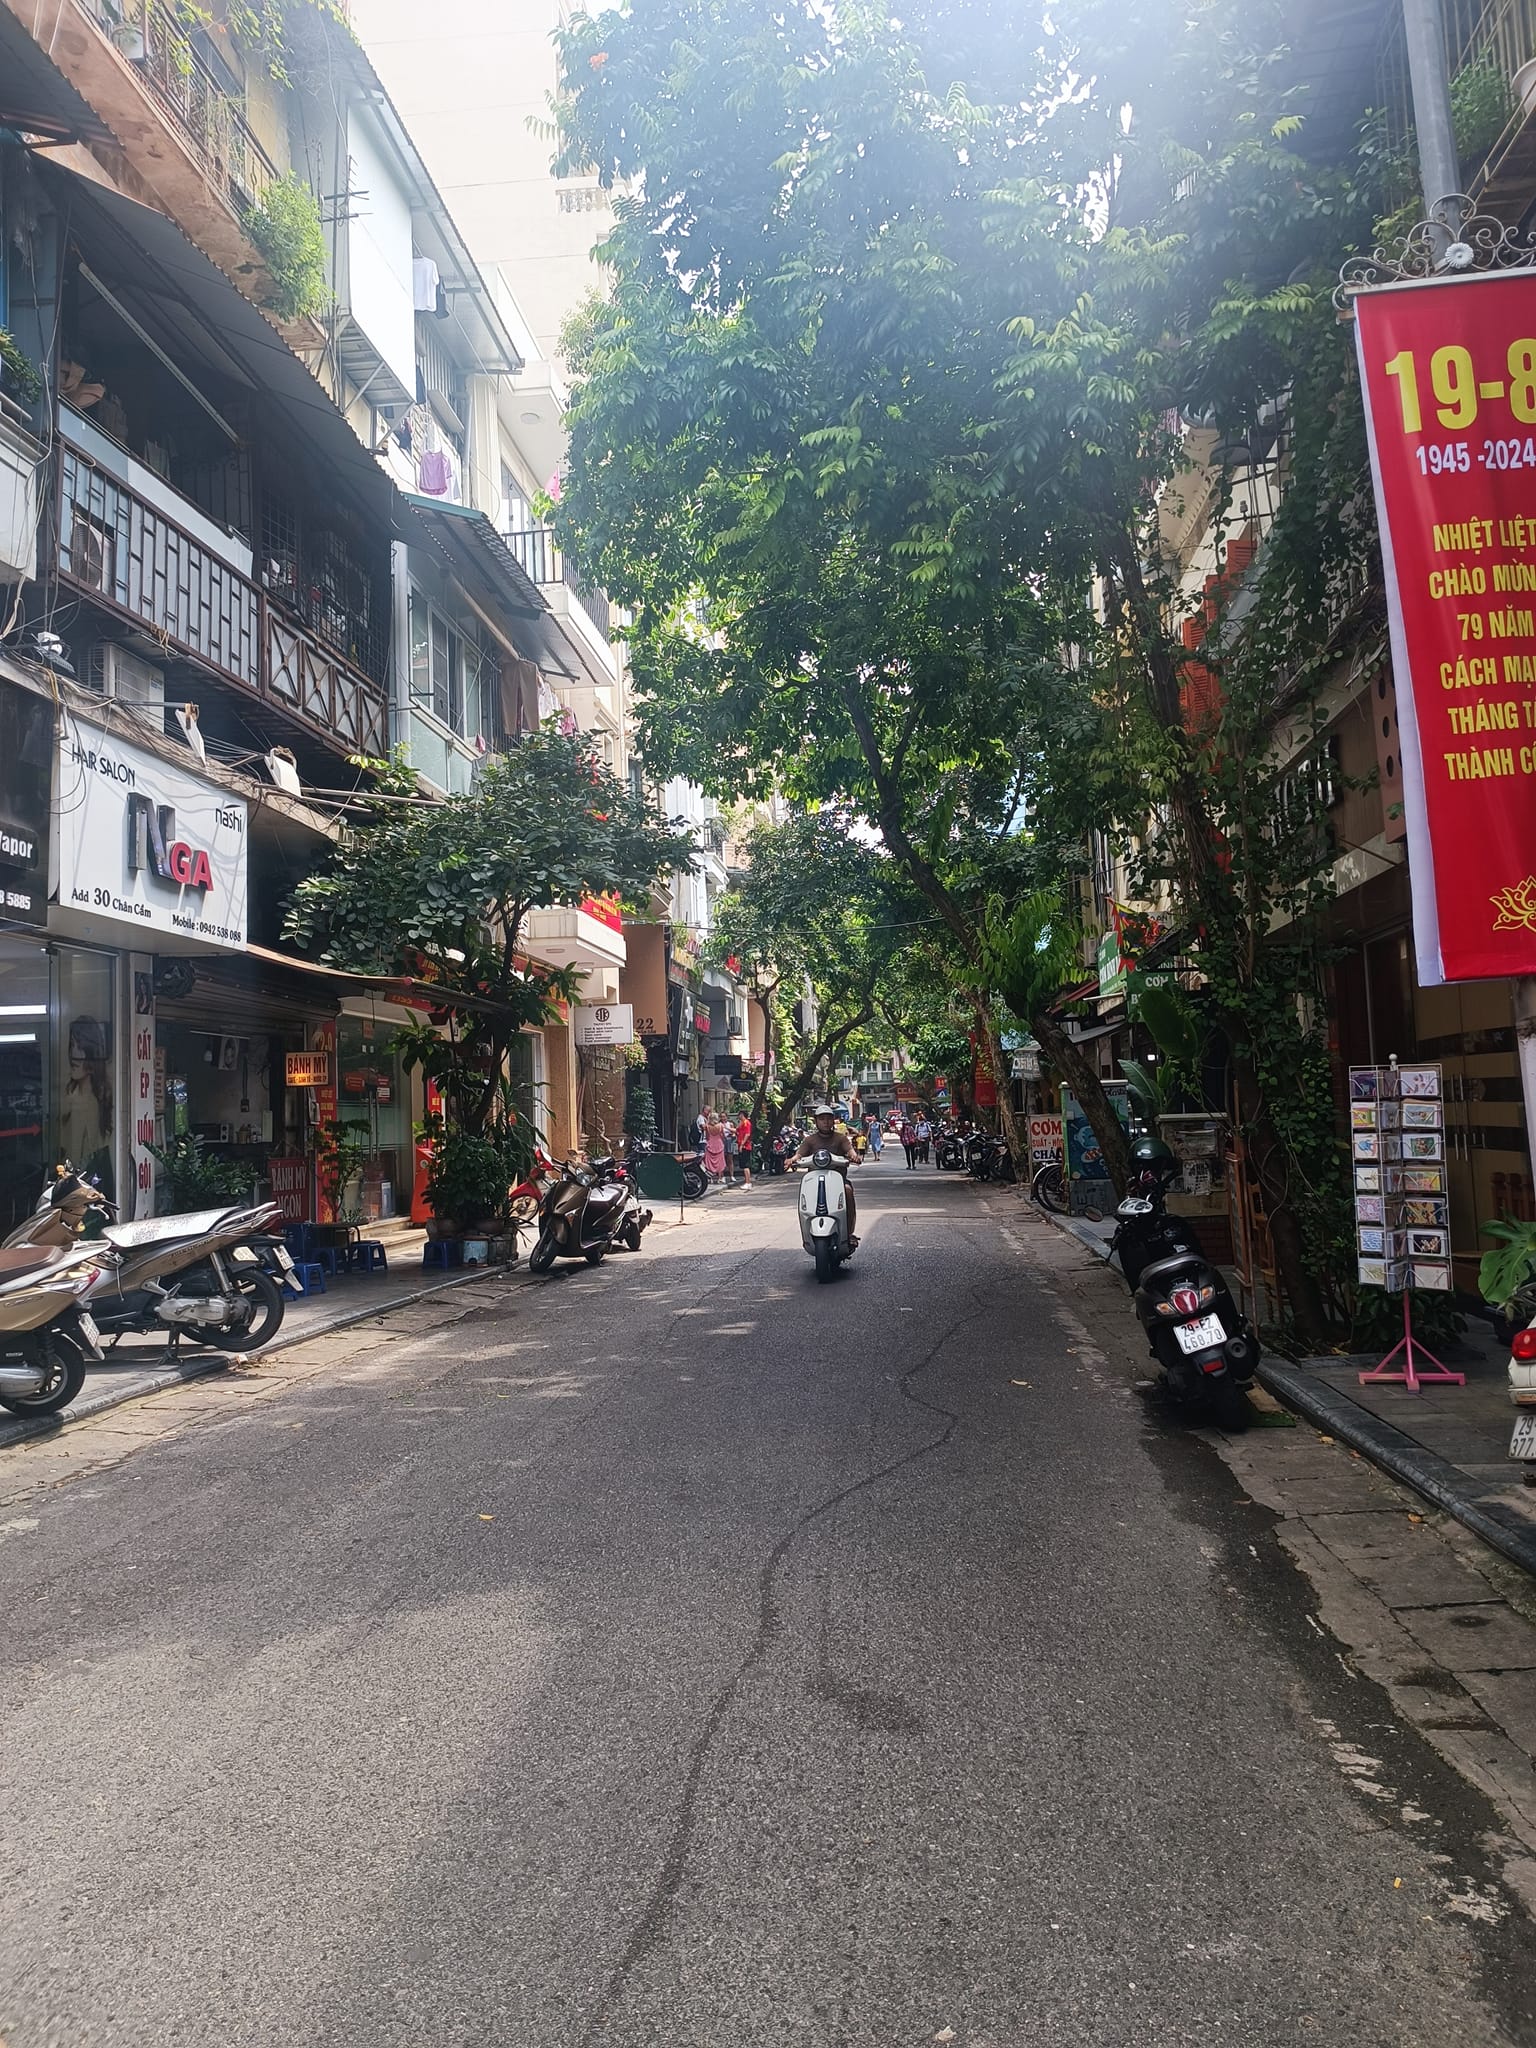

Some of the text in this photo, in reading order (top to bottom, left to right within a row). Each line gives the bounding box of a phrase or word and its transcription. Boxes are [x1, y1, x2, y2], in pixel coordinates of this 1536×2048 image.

[1385, 338, 1536, 434] 19-8
[1416, 441, 1471, 475] 1945
[1432, 514, 1536, 554] NHIỆT LIỆT
[1429, 562, 1486, 600] CHÀO
[1456, 603, 1535, 641] 79 NĂM
[1439, 654, 1499, 691] CÁCH
[1447, 696, 1536, 735] THÁNG T
[72, 744, 136, 787] HAIR SALON
[1444, 746, 1516, 781] THÀNH
[215, 805, 243, 833] nashi
[6, 891, 31, 910] 5885
[72, 888, 89, 903] Add
[94, 887, 111, 908] 30
[112, 898, 133, 914] Chân
[172, 914, 195, 930] Mobile
[199, 922, 216, 936] 0942
[637, 1017, 654, 1030] 22
[288, 1053, 311, 1075] BÁNH
[140, 1067, 150, 1099] ÉP
[1031, 1118, 1062, 1136] CƠM
